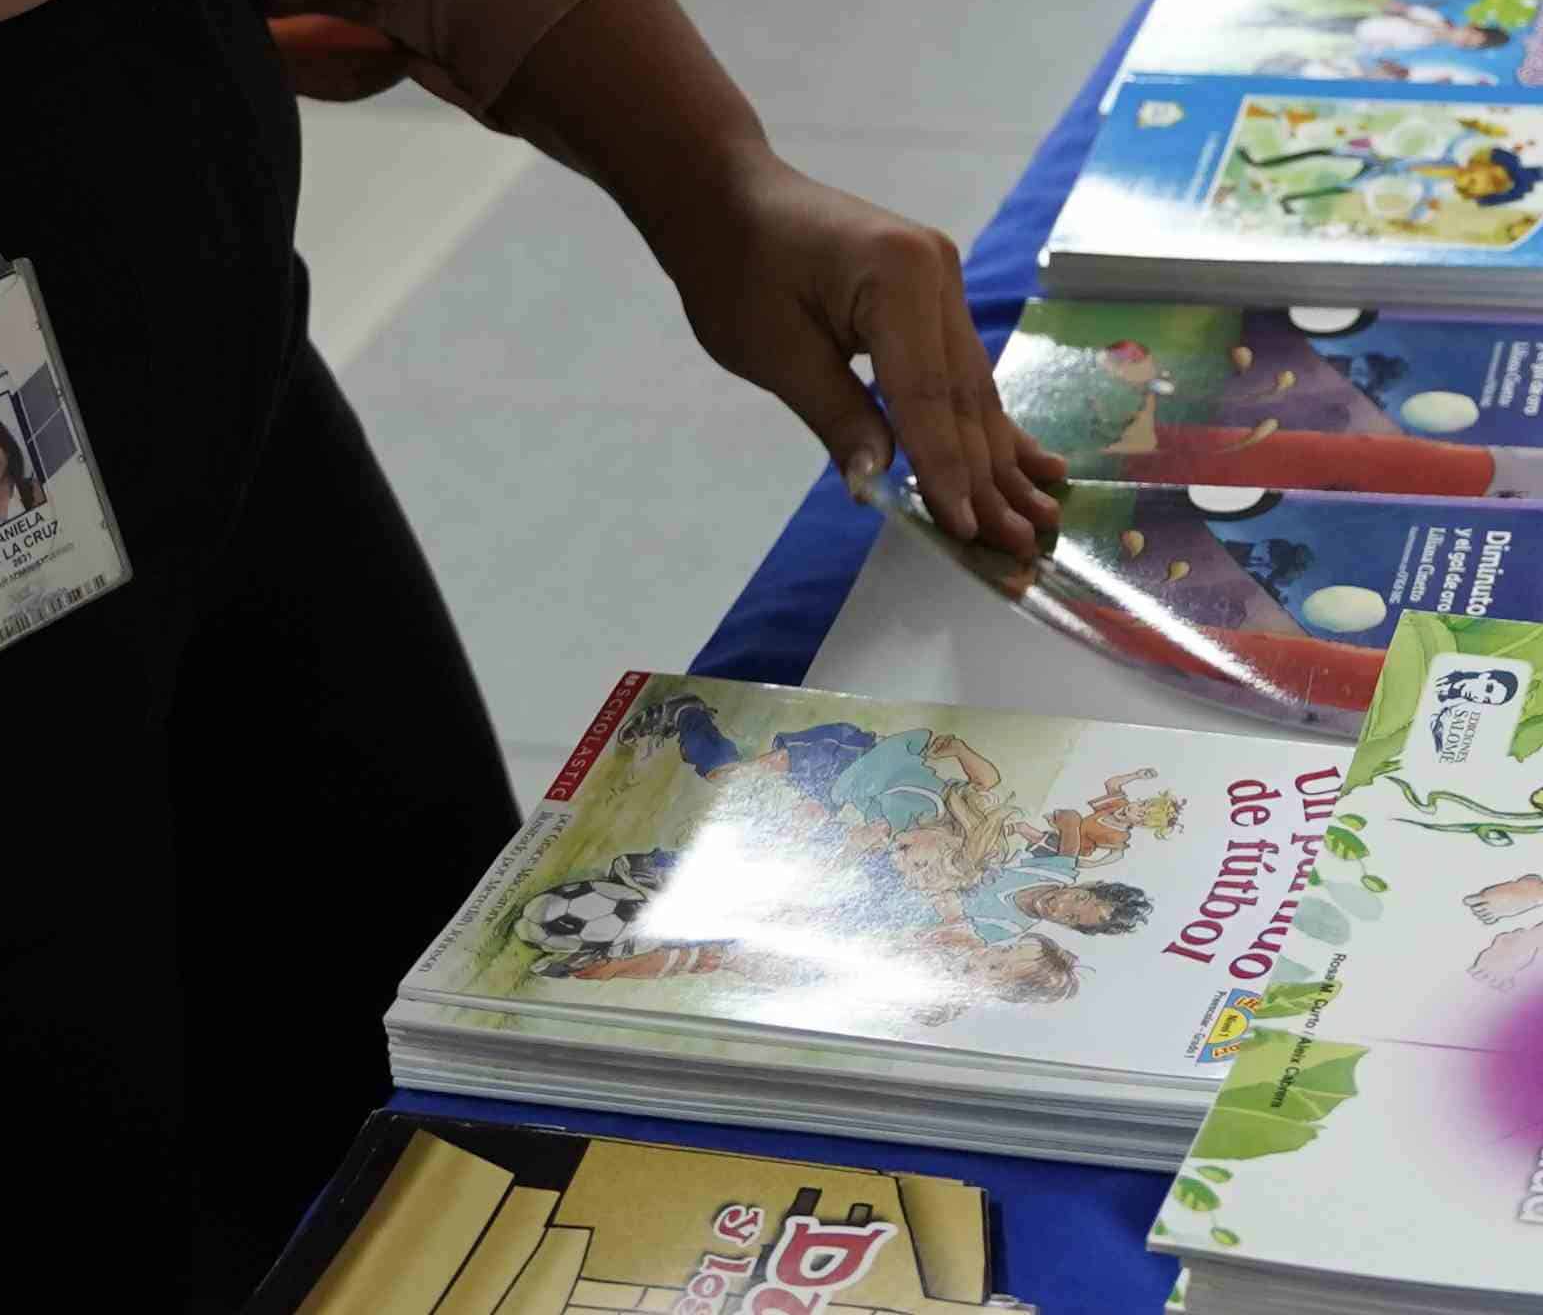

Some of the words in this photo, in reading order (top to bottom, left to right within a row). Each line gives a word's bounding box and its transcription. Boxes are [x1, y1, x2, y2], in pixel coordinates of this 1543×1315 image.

[1523, 393, 1542, 416] oro
[3, 542, 22, 561] LA
[23, 521, 59, 550] CRUZ
[1420, 526, 1447, 564] Liliana
[1454, 527, 1473, 538] y
[1454, 538, 1472, 552] el
[1443, 573, 1463, 590] de
[1448, 552, 1466, 573] gol
[1466, 531, 1512, 617] Diminuto
[1409, 564, 1436, 603] Cinetto
[1437, 590, 1455, 612] oro
[550, 687, 633, 799] SCHOLASTIC
[1457, 710, 1481, 764] EDICIONES
[1227, 779, 1282, 827] de
[1162, 839, 1279, 964] fútbol
[419, 925, 463, 973] Johnson
[1324, 953, 1347, 981] Rosa
[1305, 998, 1329, 1029] Curto
[1289, 1035, 1312, 1064] Aleix
[1269, 1065, 1300, 1108] Cabrera
[714, 1204, 764, 1248] y
